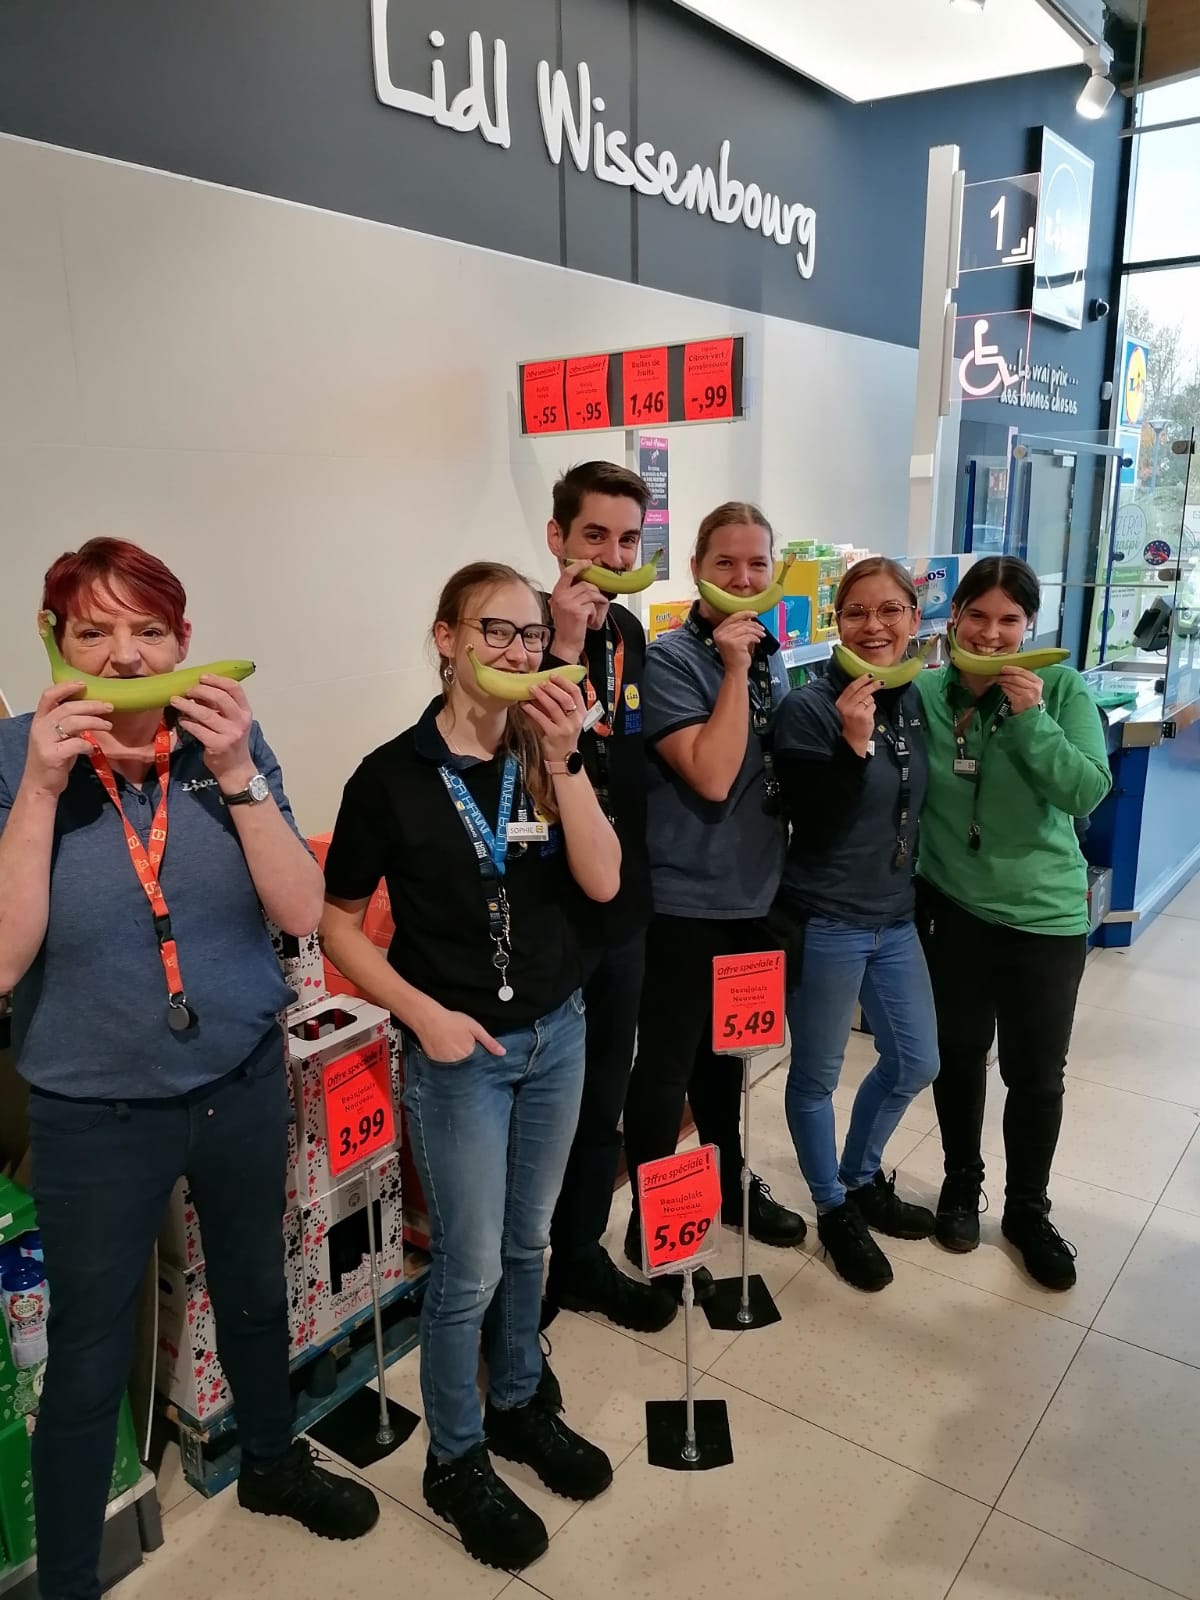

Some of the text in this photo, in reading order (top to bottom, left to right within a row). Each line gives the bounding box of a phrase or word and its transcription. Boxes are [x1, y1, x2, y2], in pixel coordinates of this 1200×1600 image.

[371, 0, 817, 280] Lidl Wissembourg
[990, 195, 1006, 251] 1
[1032, 363, 1050, 383] vrai
[629, 391, 665, 418] 1,46
[691, 384, 727, 413] -,99
[1051, 387, 1078, 415] choses
[532, 406, 557, 428] -,55
[576, 402, 602, 425] -,95
[717, 965, 739, 976] Offre
[723, 1010, 775, 1040] 5,49
[339, 1108, 385, 1157] 3,99
[644, 1173, 667, 1186] Offre
[668, 1158, 703, 1178] spéciale
[660, 1191, 703, 1206] Beaujolais
[654, 1218, 711, 1251] 5,69
